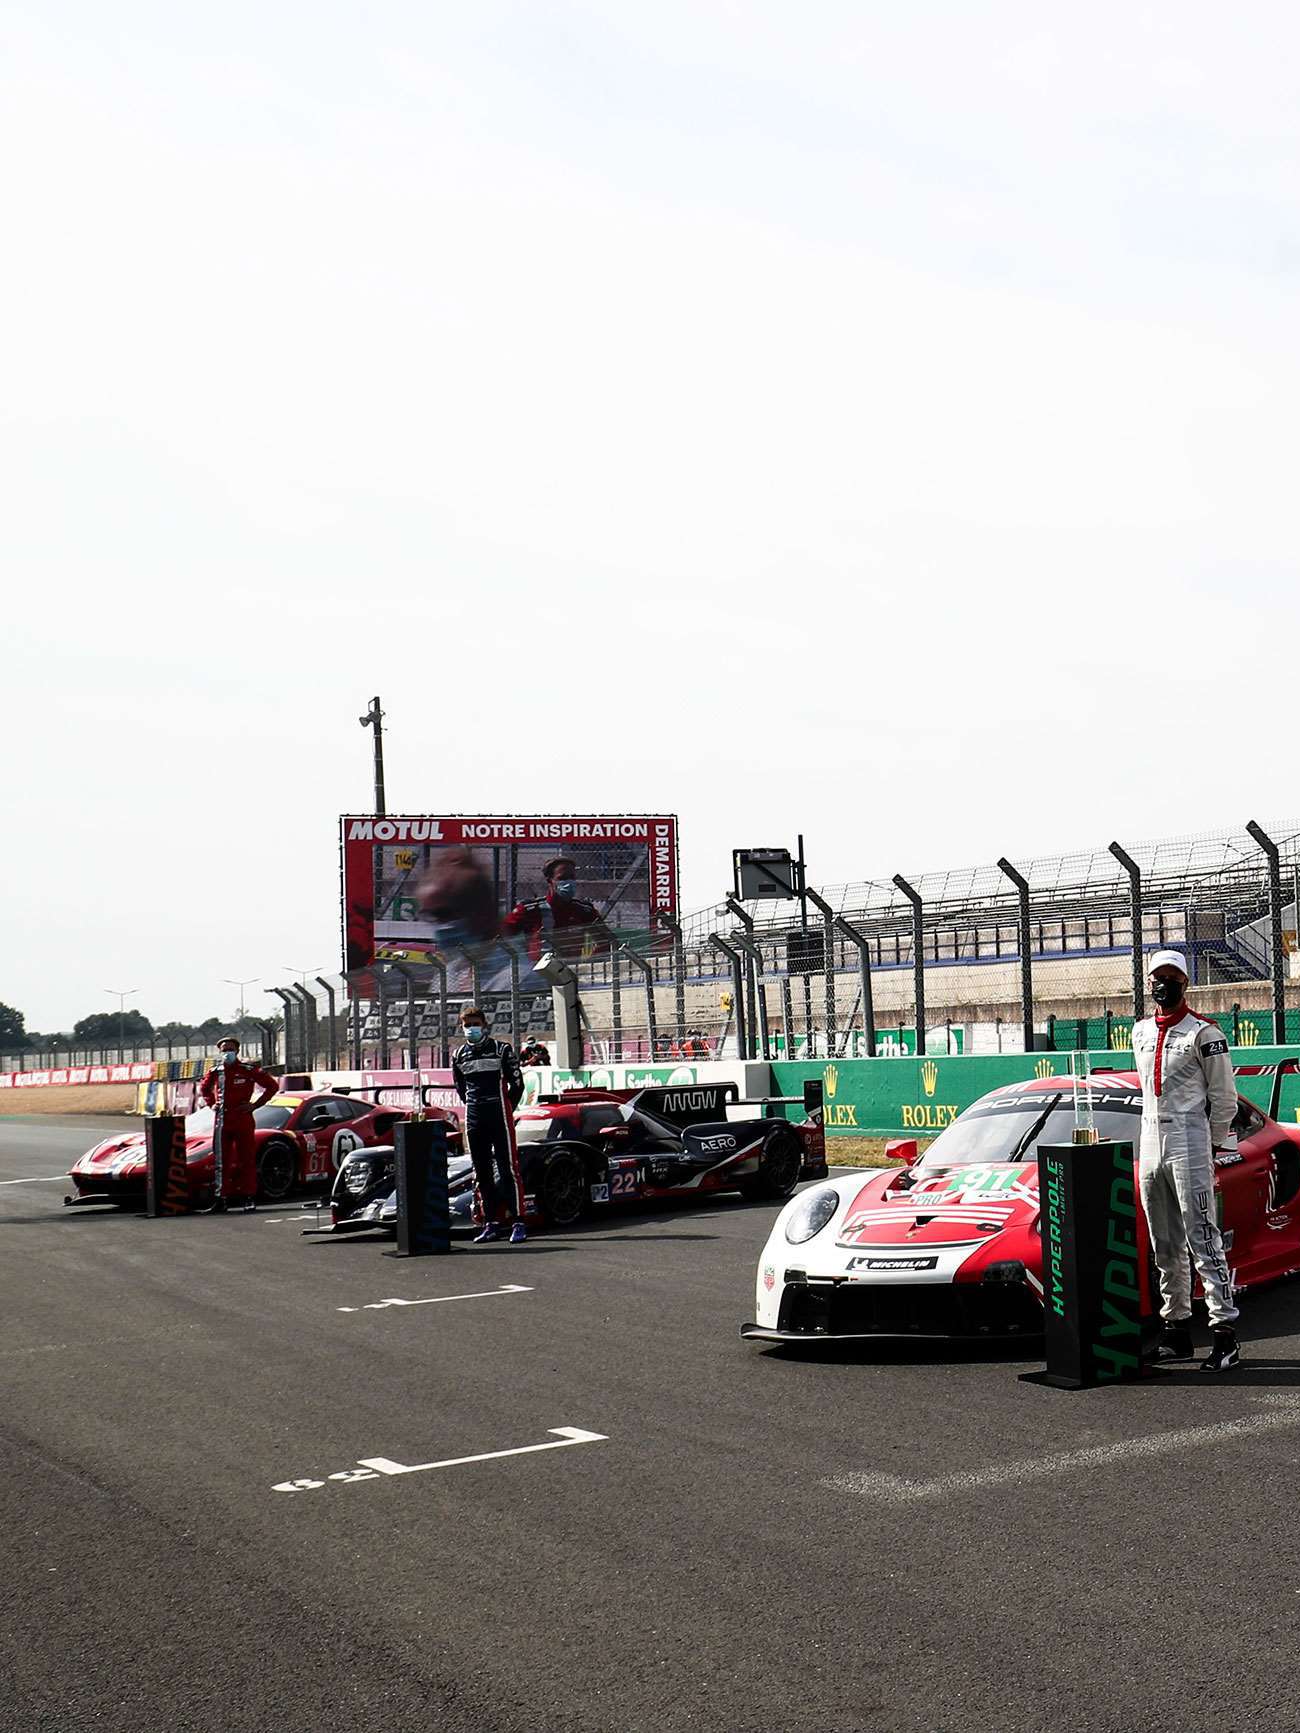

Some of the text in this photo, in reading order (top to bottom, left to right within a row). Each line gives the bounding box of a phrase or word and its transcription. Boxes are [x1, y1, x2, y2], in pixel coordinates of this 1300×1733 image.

[348, 820, 444, 841] MOTUL
[461, 823, 648, 838] NOTRE INSPIRATION
[655, 824, 671, 908] DEMARRE
[858, 1036, 909, 1057] Srthe
[822, 1105, 857, 1126] LEX
[902, 1105, 958, 1128] ROLEX
[701, 1137, 736, 1153] AERO
[309, 1153, 327, 1172] 61
[612, 1173, 635, 1195] 22
[961, 1168, 1007, 1191] 91
[1046, 1156, 1065, 1317] HYPERPOLE
[869, 1259, 931, 1269] MICHELIN
